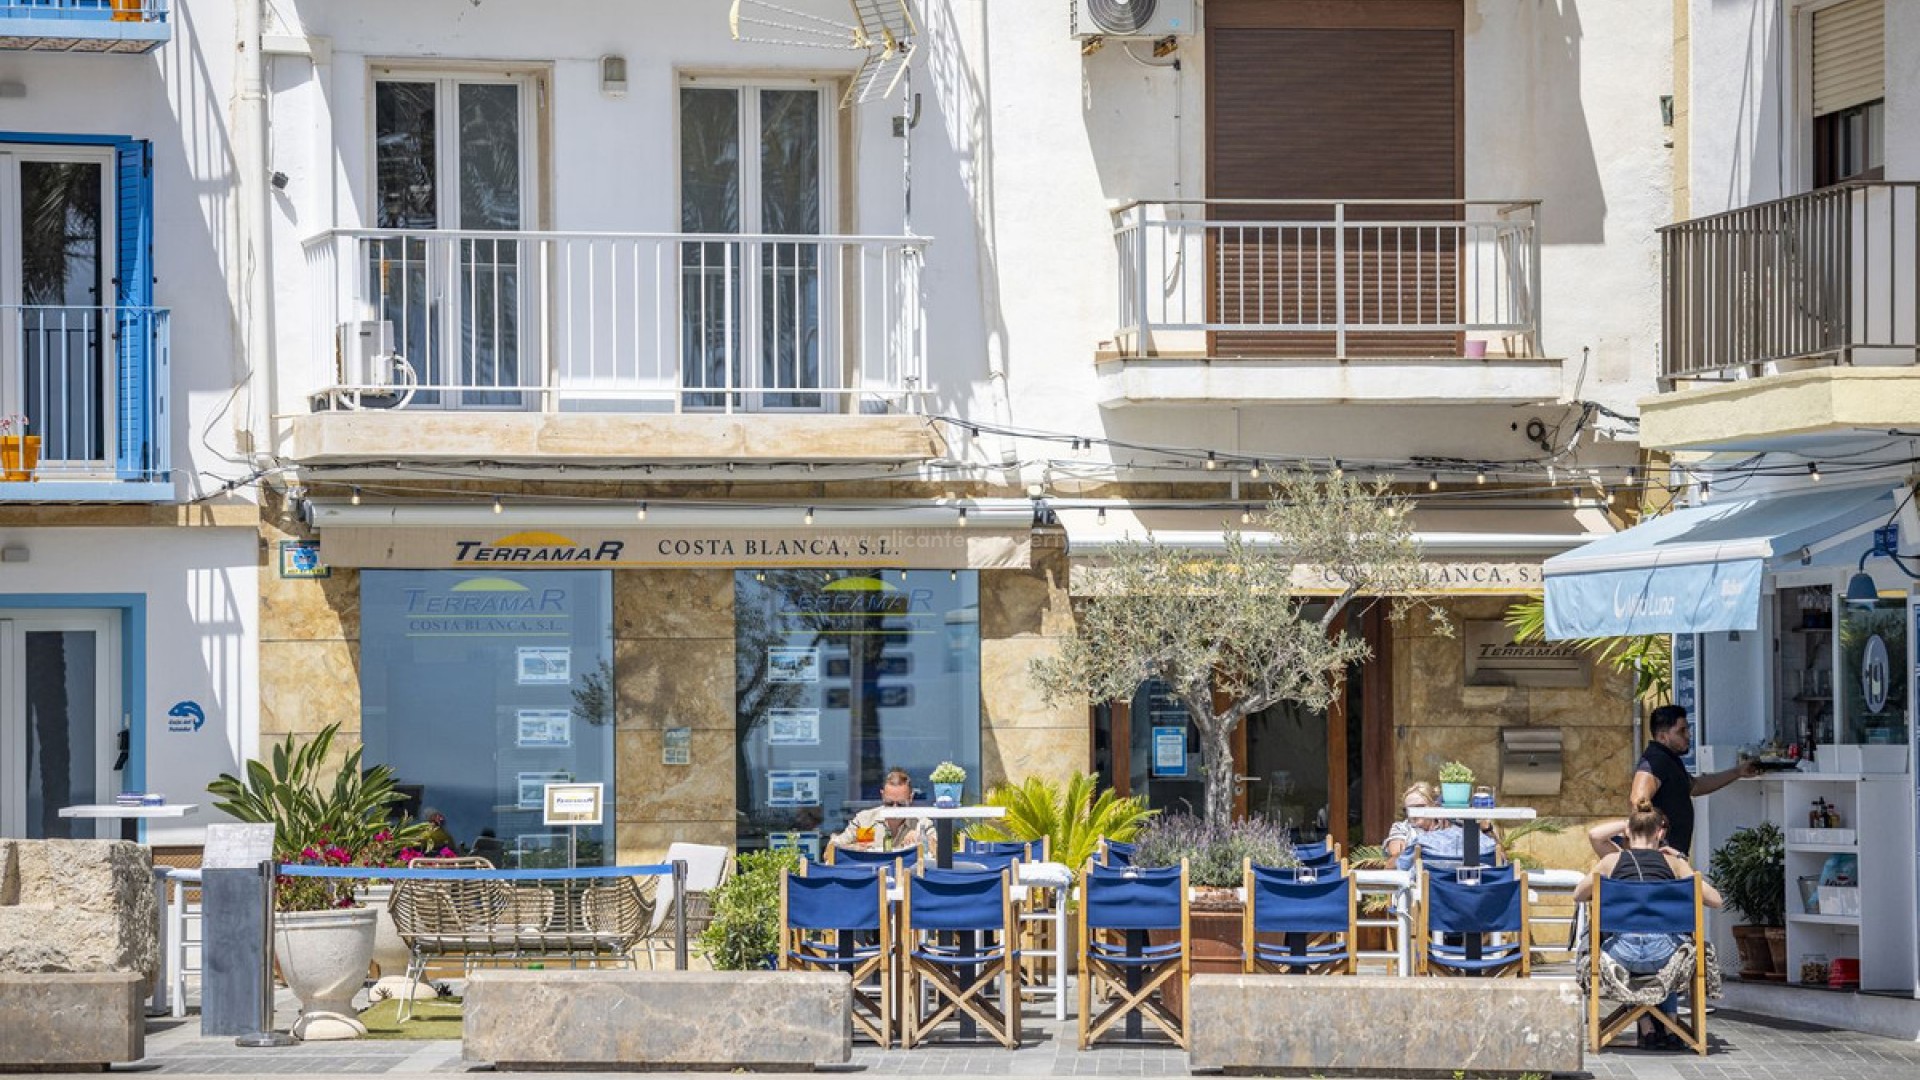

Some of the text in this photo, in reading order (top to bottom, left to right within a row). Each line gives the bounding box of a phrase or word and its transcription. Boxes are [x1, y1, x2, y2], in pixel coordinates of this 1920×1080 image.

[456, 541, 624, 561] TERRAMAR
[658, 540, 900, 558] COSTA BLANCA, S.L.
[404, 589, 566, 612] TERRAMAR
[410, 619, 459, 631] COSTA
